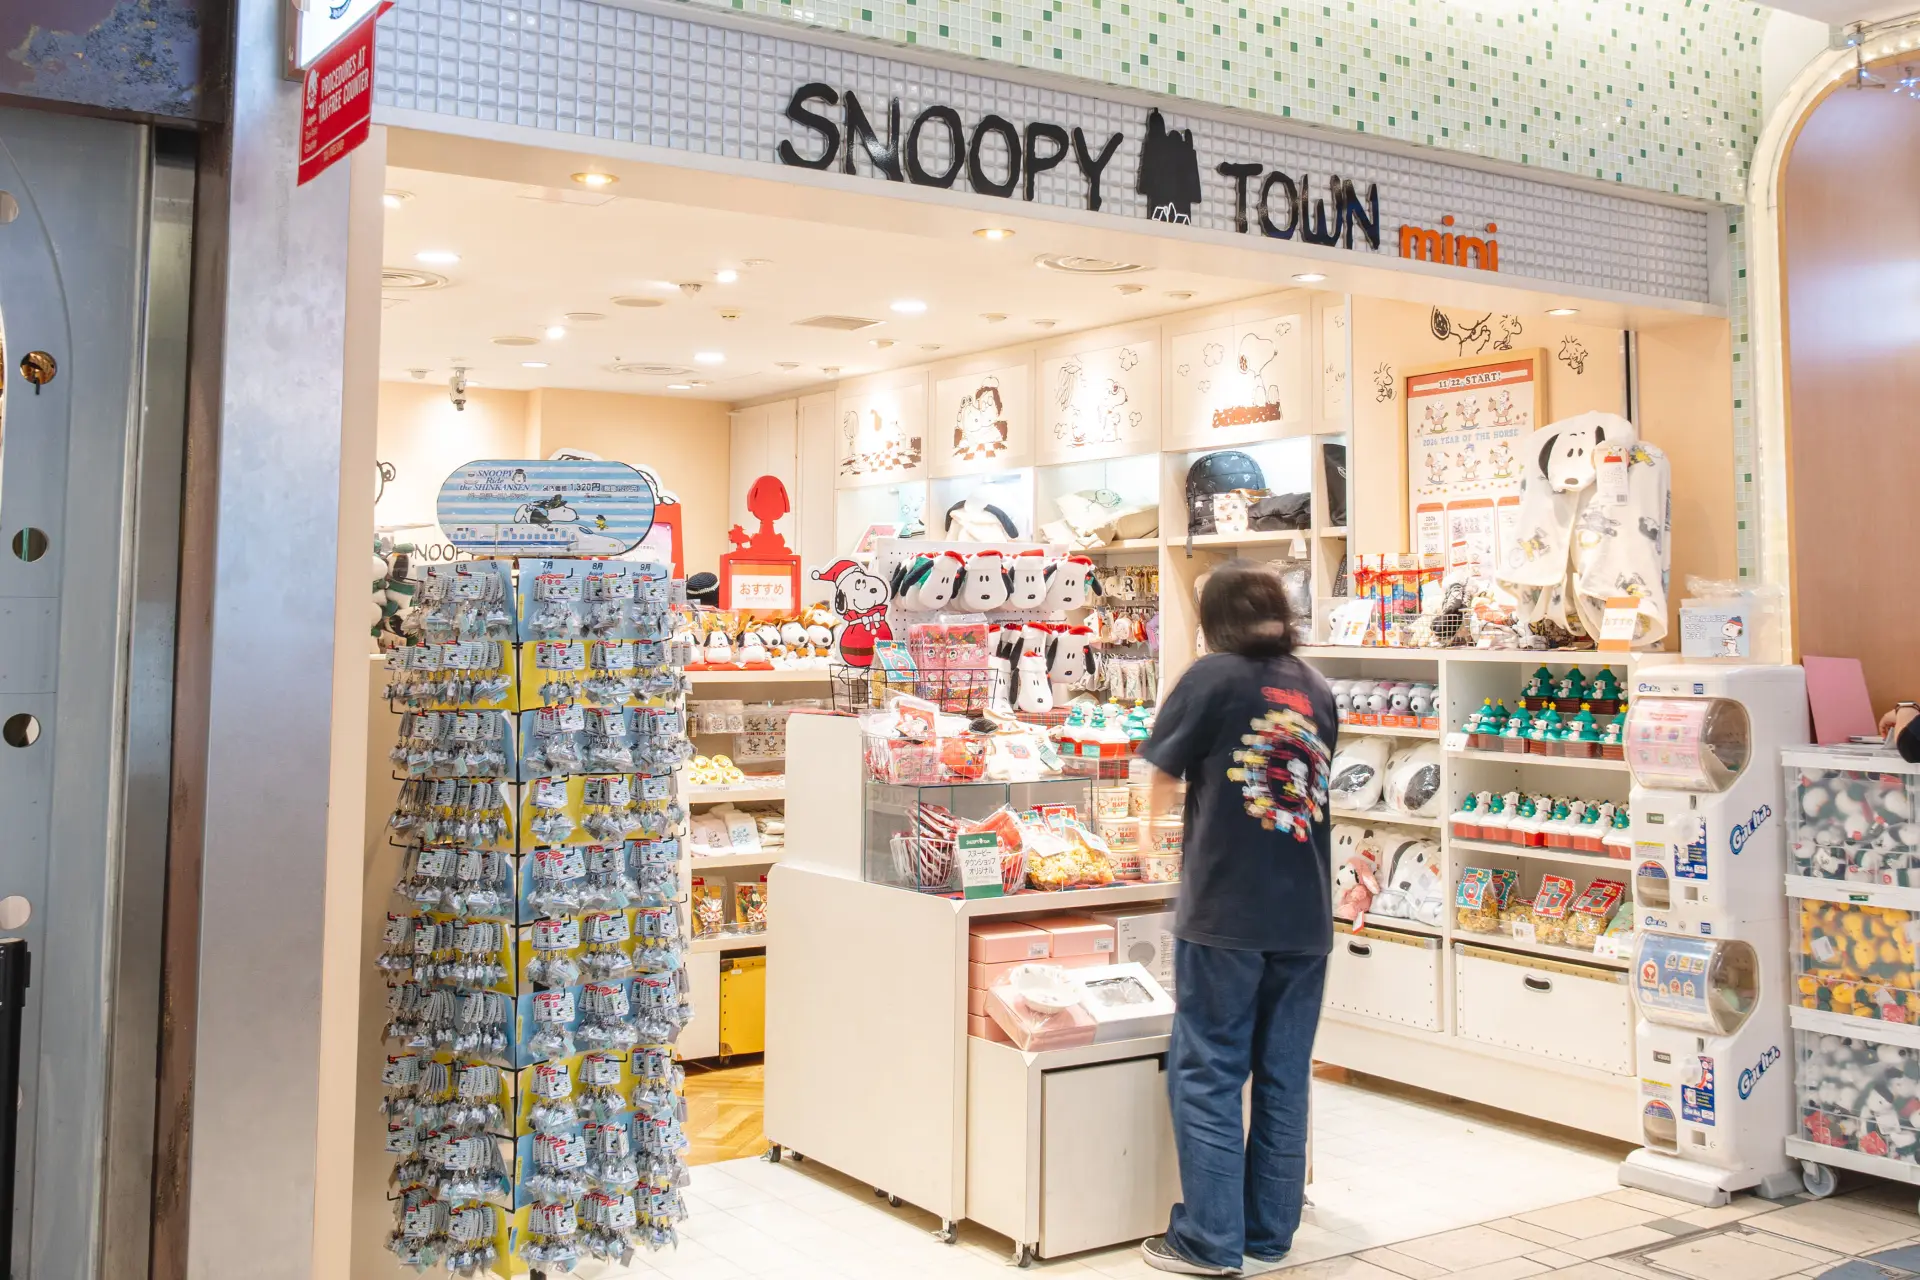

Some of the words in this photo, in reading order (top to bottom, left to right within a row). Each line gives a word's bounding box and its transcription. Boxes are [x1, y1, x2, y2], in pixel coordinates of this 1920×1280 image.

[321, 53, 357, 99] PROCEDURES
[357, 45, 366, 71] AT
[318, 88, 342, 125] TAX-FREE
[342, 68, 369, 105] COUNTER
[780, 82, 1124, 212] SNOOPY
[1217, 161, 1381, 250] TOWN
[1399, 215, 1498, 272] mini
[1465, 372, 1501, 385] START!
[1441, 435, 1459, 445] YEAR
[1476, 432, 1490, 441] THE
[1494, 428, 1518, 439] HORSE
[477, 469, 513, 478] SNOOPY
[542, 560, 553, 570] 7月
[592, 562, 604, 570] 8月
[640, 563, 651, 572] 9月
[740, 583, 784, 595] おすすめ
[969, 866, 995, 875] オリジナル
